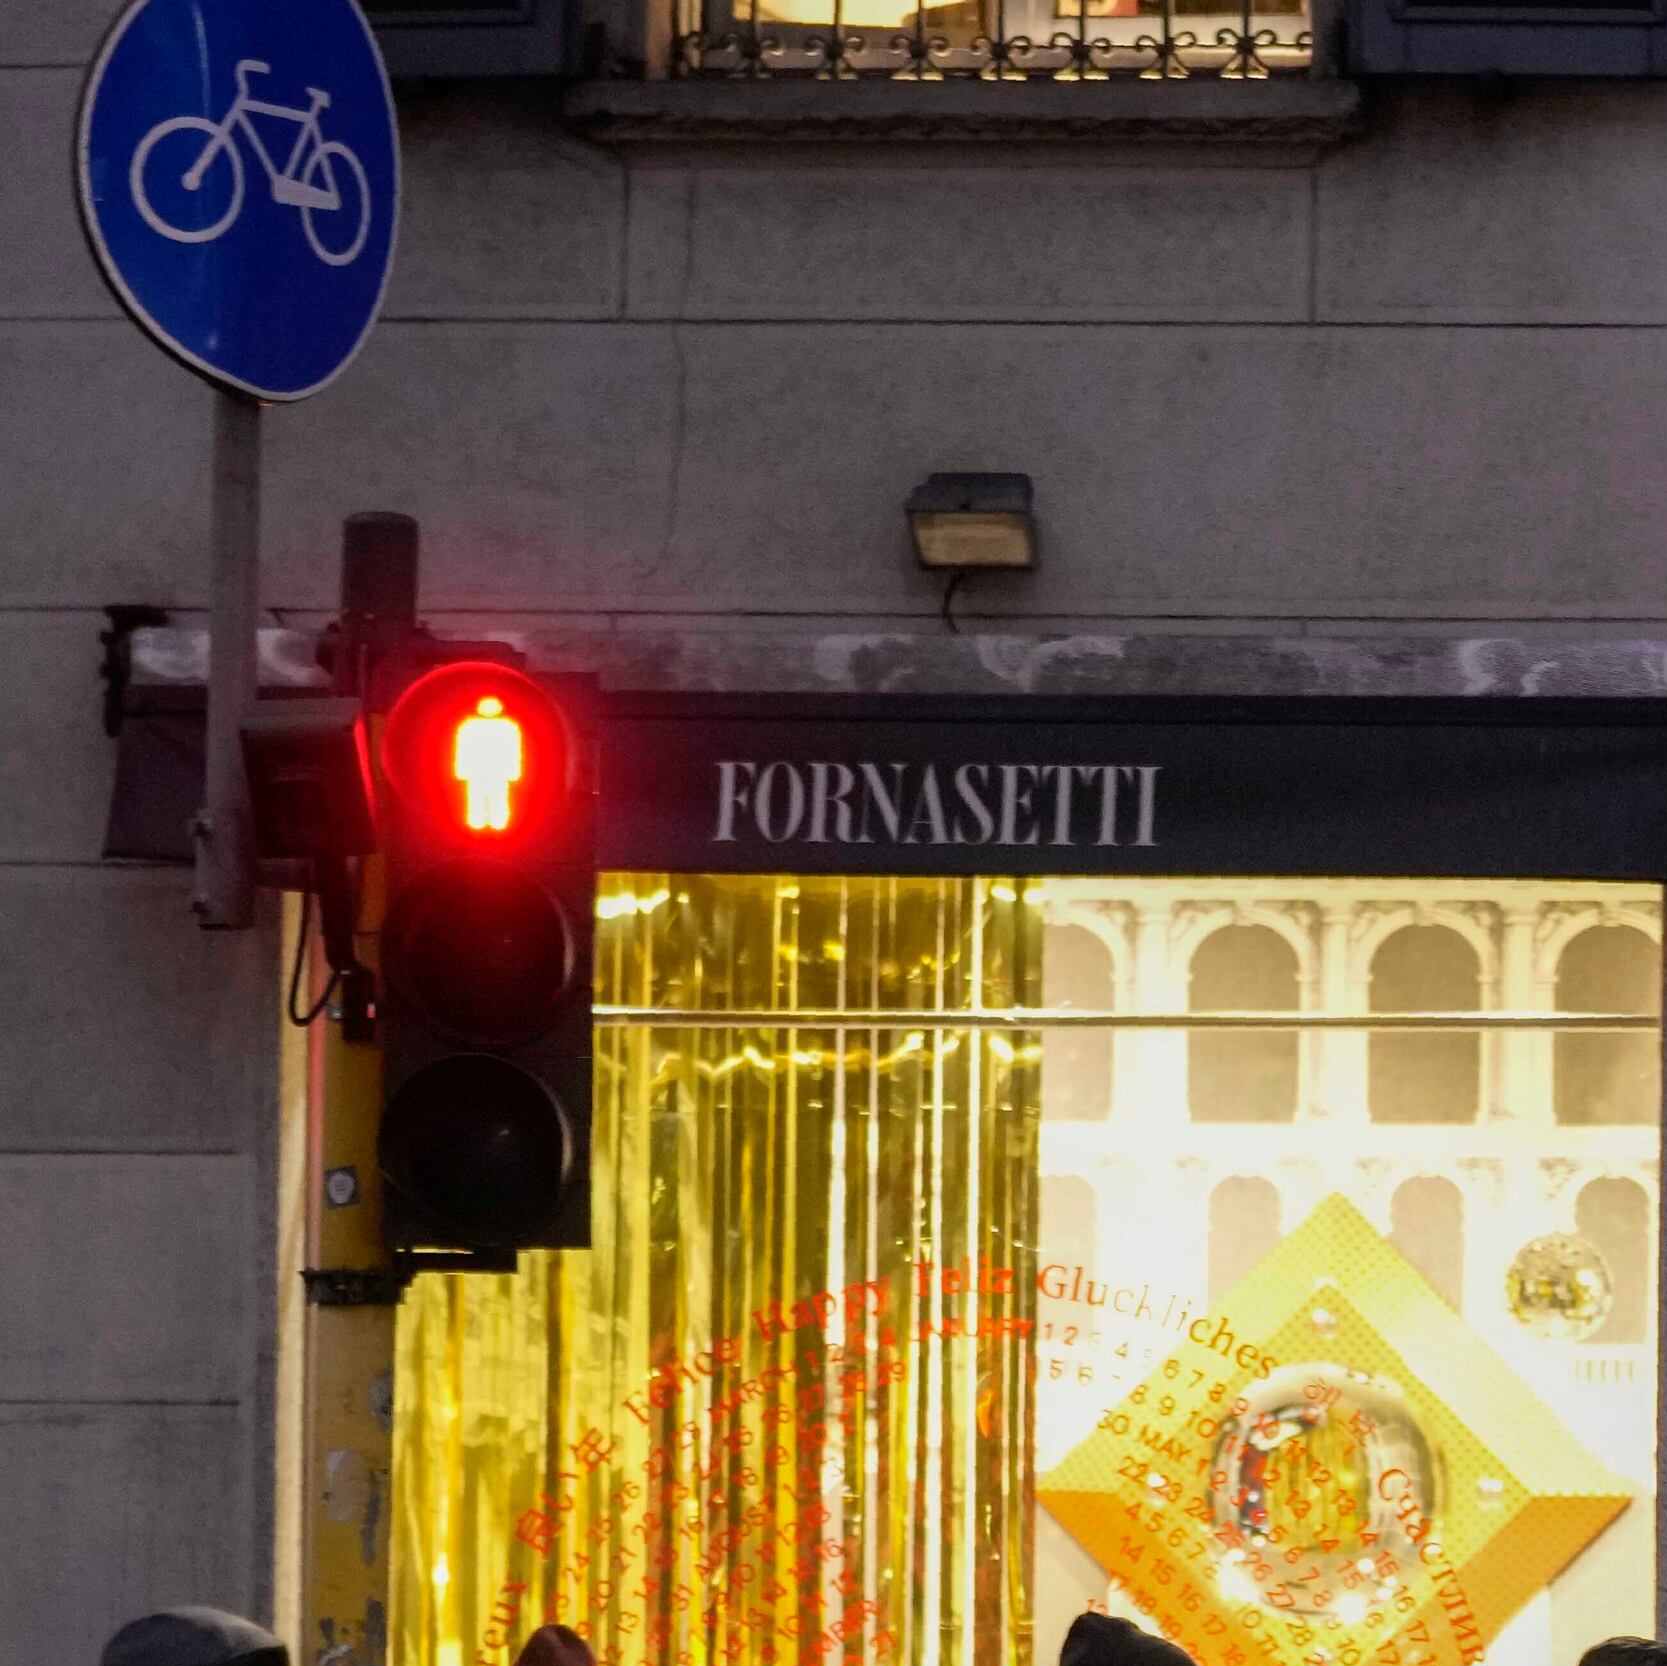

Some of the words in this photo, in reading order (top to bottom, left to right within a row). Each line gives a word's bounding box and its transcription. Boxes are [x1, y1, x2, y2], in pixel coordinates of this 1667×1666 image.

[712, 761, 1162, 847] FORNASETTI
[912, 1255, 1014, 1298] Feliz
[752, 1276, 891, 1343] Happy
[1137, 1425, 1191, 1463] MAY
